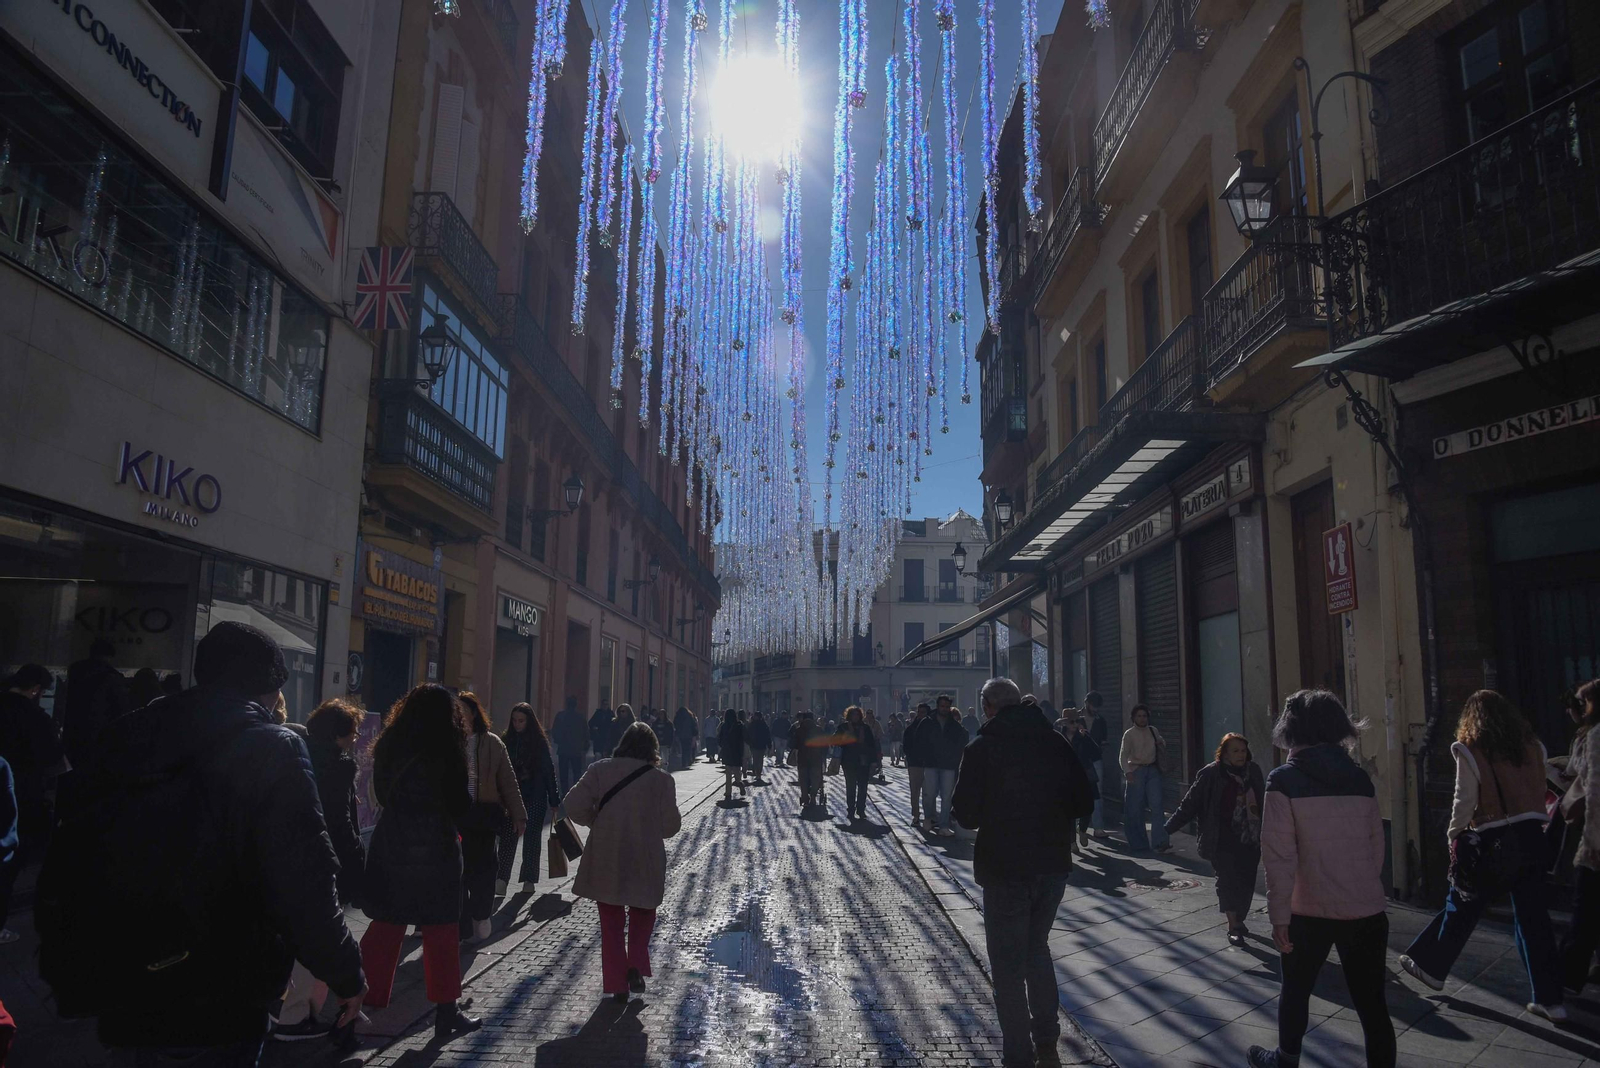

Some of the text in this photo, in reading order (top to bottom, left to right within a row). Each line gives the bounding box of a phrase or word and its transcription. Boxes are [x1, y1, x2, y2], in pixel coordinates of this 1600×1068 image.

[74, 4, 203, 138] CONNECTION
[300, 246, 325, 276] TRINITY
[1434, 438, 1449, 455] O
[117, 441, 222, 514] KIKO
[143, 501, 199, 528] MILANO
[1127, 520, 1154, 551] POZO
[385, 569, 438, 604] TABACOS
[1328, 581, 1352, 594] HIDRANTE
[1330, 590, 1351, 602] CONTRA
[508, 598, 538, 626] MANGO
[1329, 597, 1353, 610] INCENDIOS
[74, 606, 174, 633] KIKO
